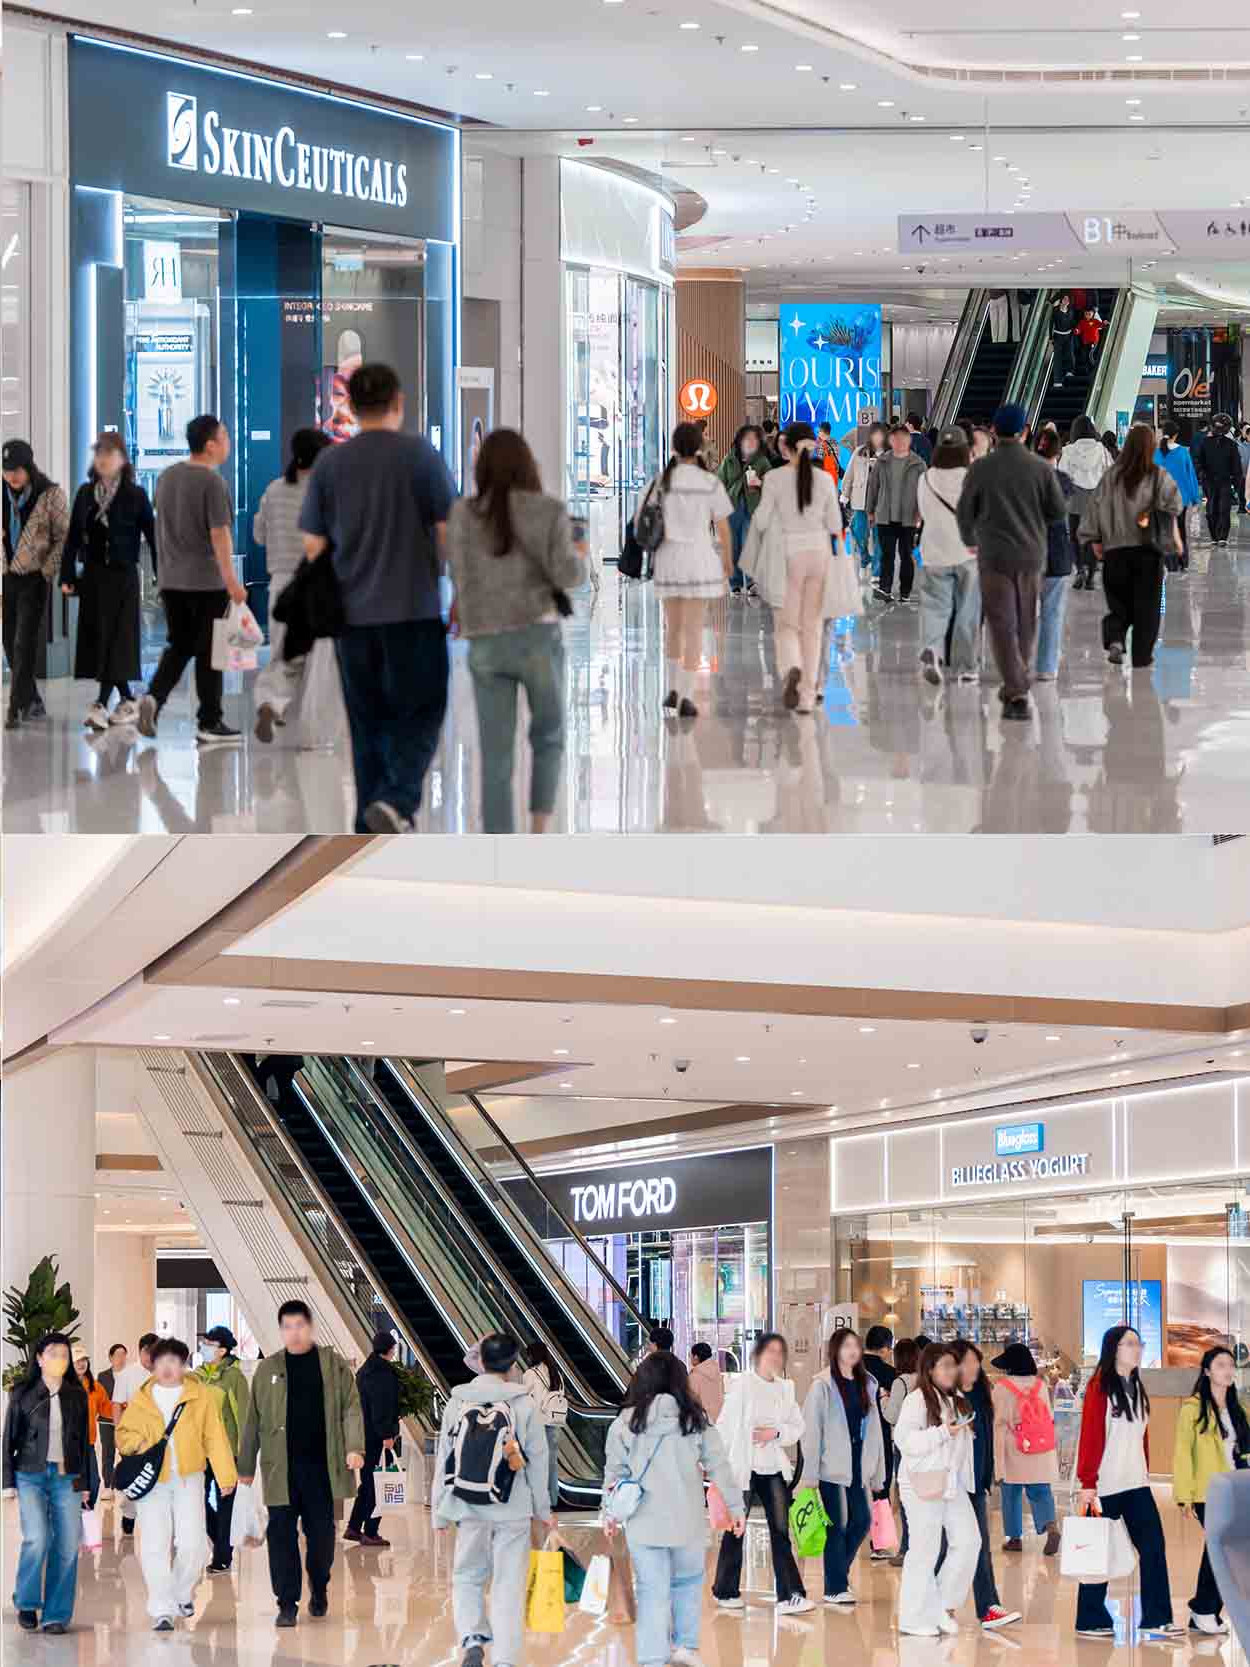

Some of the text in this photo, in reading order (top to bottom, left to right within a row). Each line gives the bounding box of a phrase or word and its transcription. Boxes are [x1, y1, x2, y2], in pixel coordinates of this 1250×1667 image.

[1084, 217, 1113, 244] B1
[781, 357, 881, 389] LOURIS
[781, 391, 876, 423] OLYMP
[952, 1153, 1088, 1187] BLUEGLASS YOGURT
[570, 1176, 677, 1221] TOM FORD
